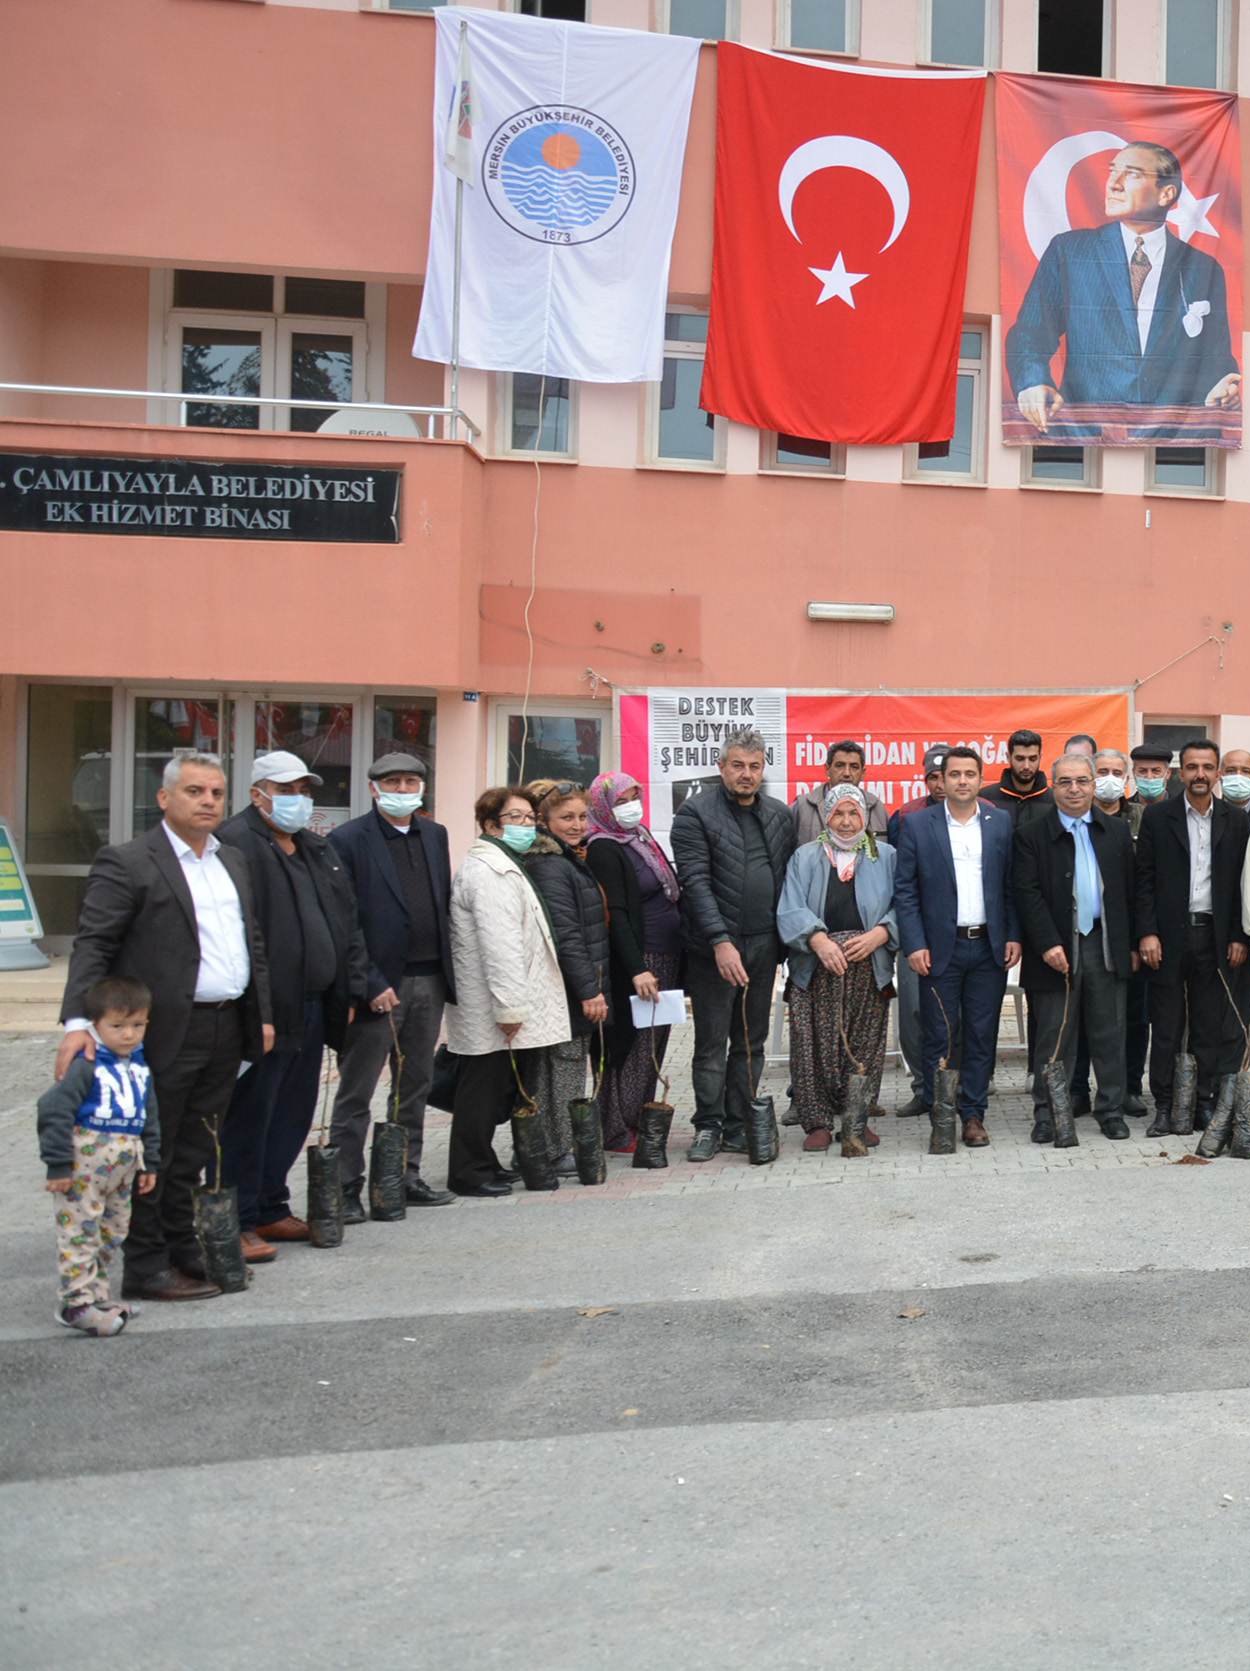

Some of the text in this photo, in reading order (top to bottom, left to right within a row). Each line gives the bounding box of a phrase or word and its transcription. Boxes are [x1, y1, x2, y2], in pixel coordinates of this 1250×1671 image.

[488, 111, 630, 196] MERSİN BÜYÜKŞEHİR BELEDİYESİ
[541, 229, 572, 243] 1873
[12, 467, 376, 503] ÇAMLIYAYLA BELEDİYESİ
[44, 499, 292, 530] EK HİZMET BİNASI
[678, 697, 755, 716] DESTEK
[855, 733, 916, 766] İDAN
